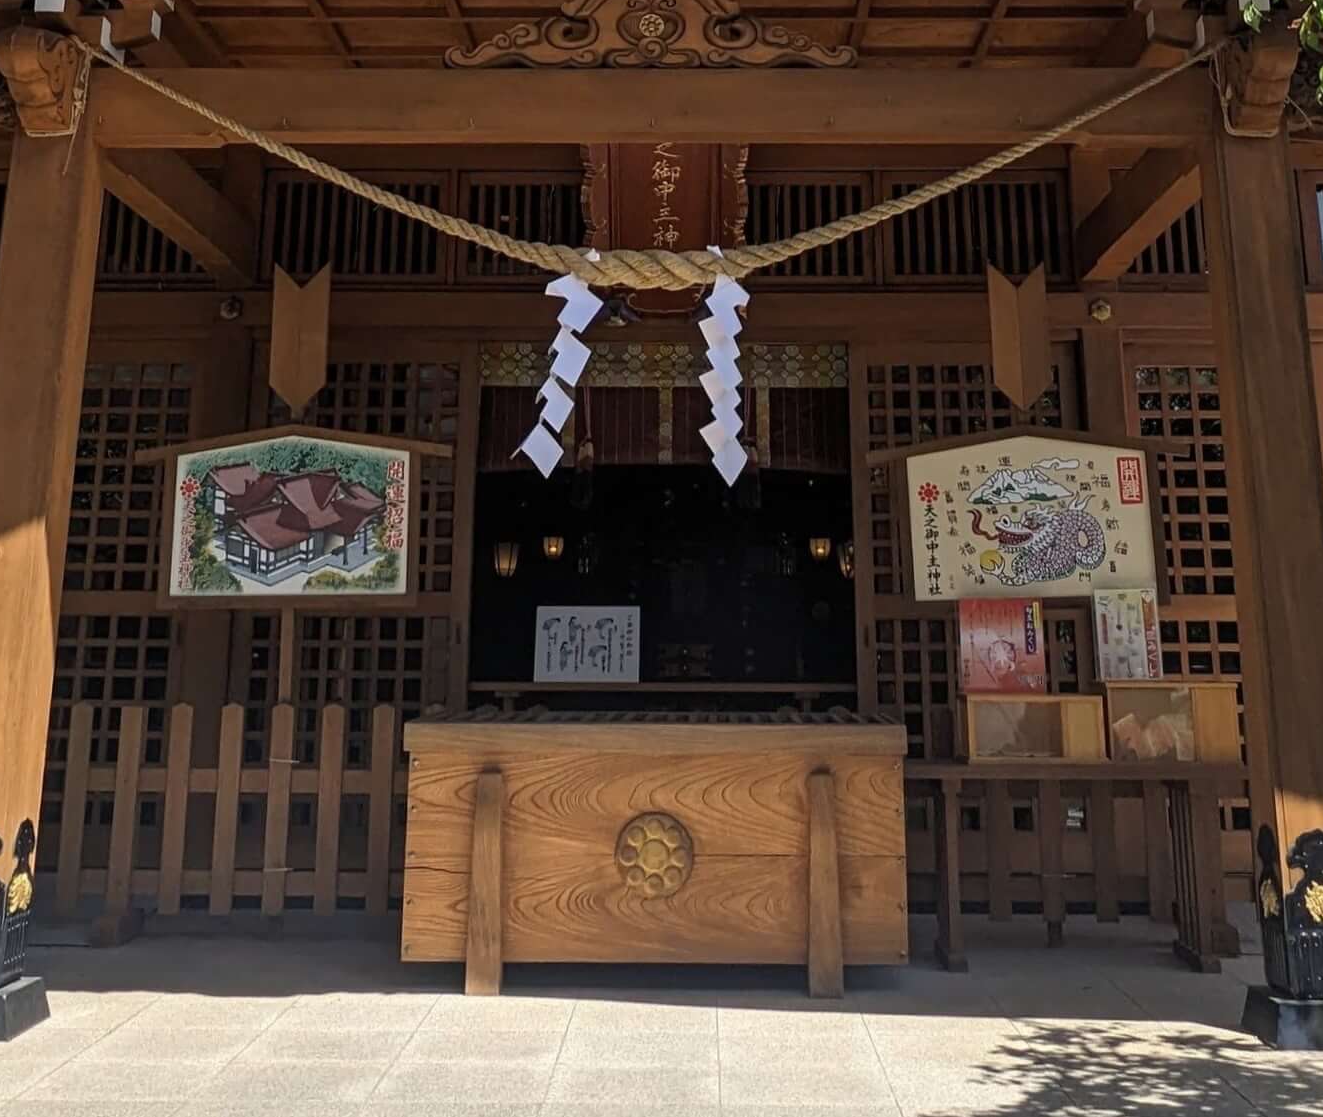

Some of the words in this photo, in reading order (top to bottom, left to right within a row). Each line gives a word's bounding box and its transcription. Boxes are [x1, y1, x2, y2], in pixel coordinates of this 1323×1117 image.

[386, 460, 406, 549] 開運招福
[923, 505, 943, 596] 天之御中主神社
